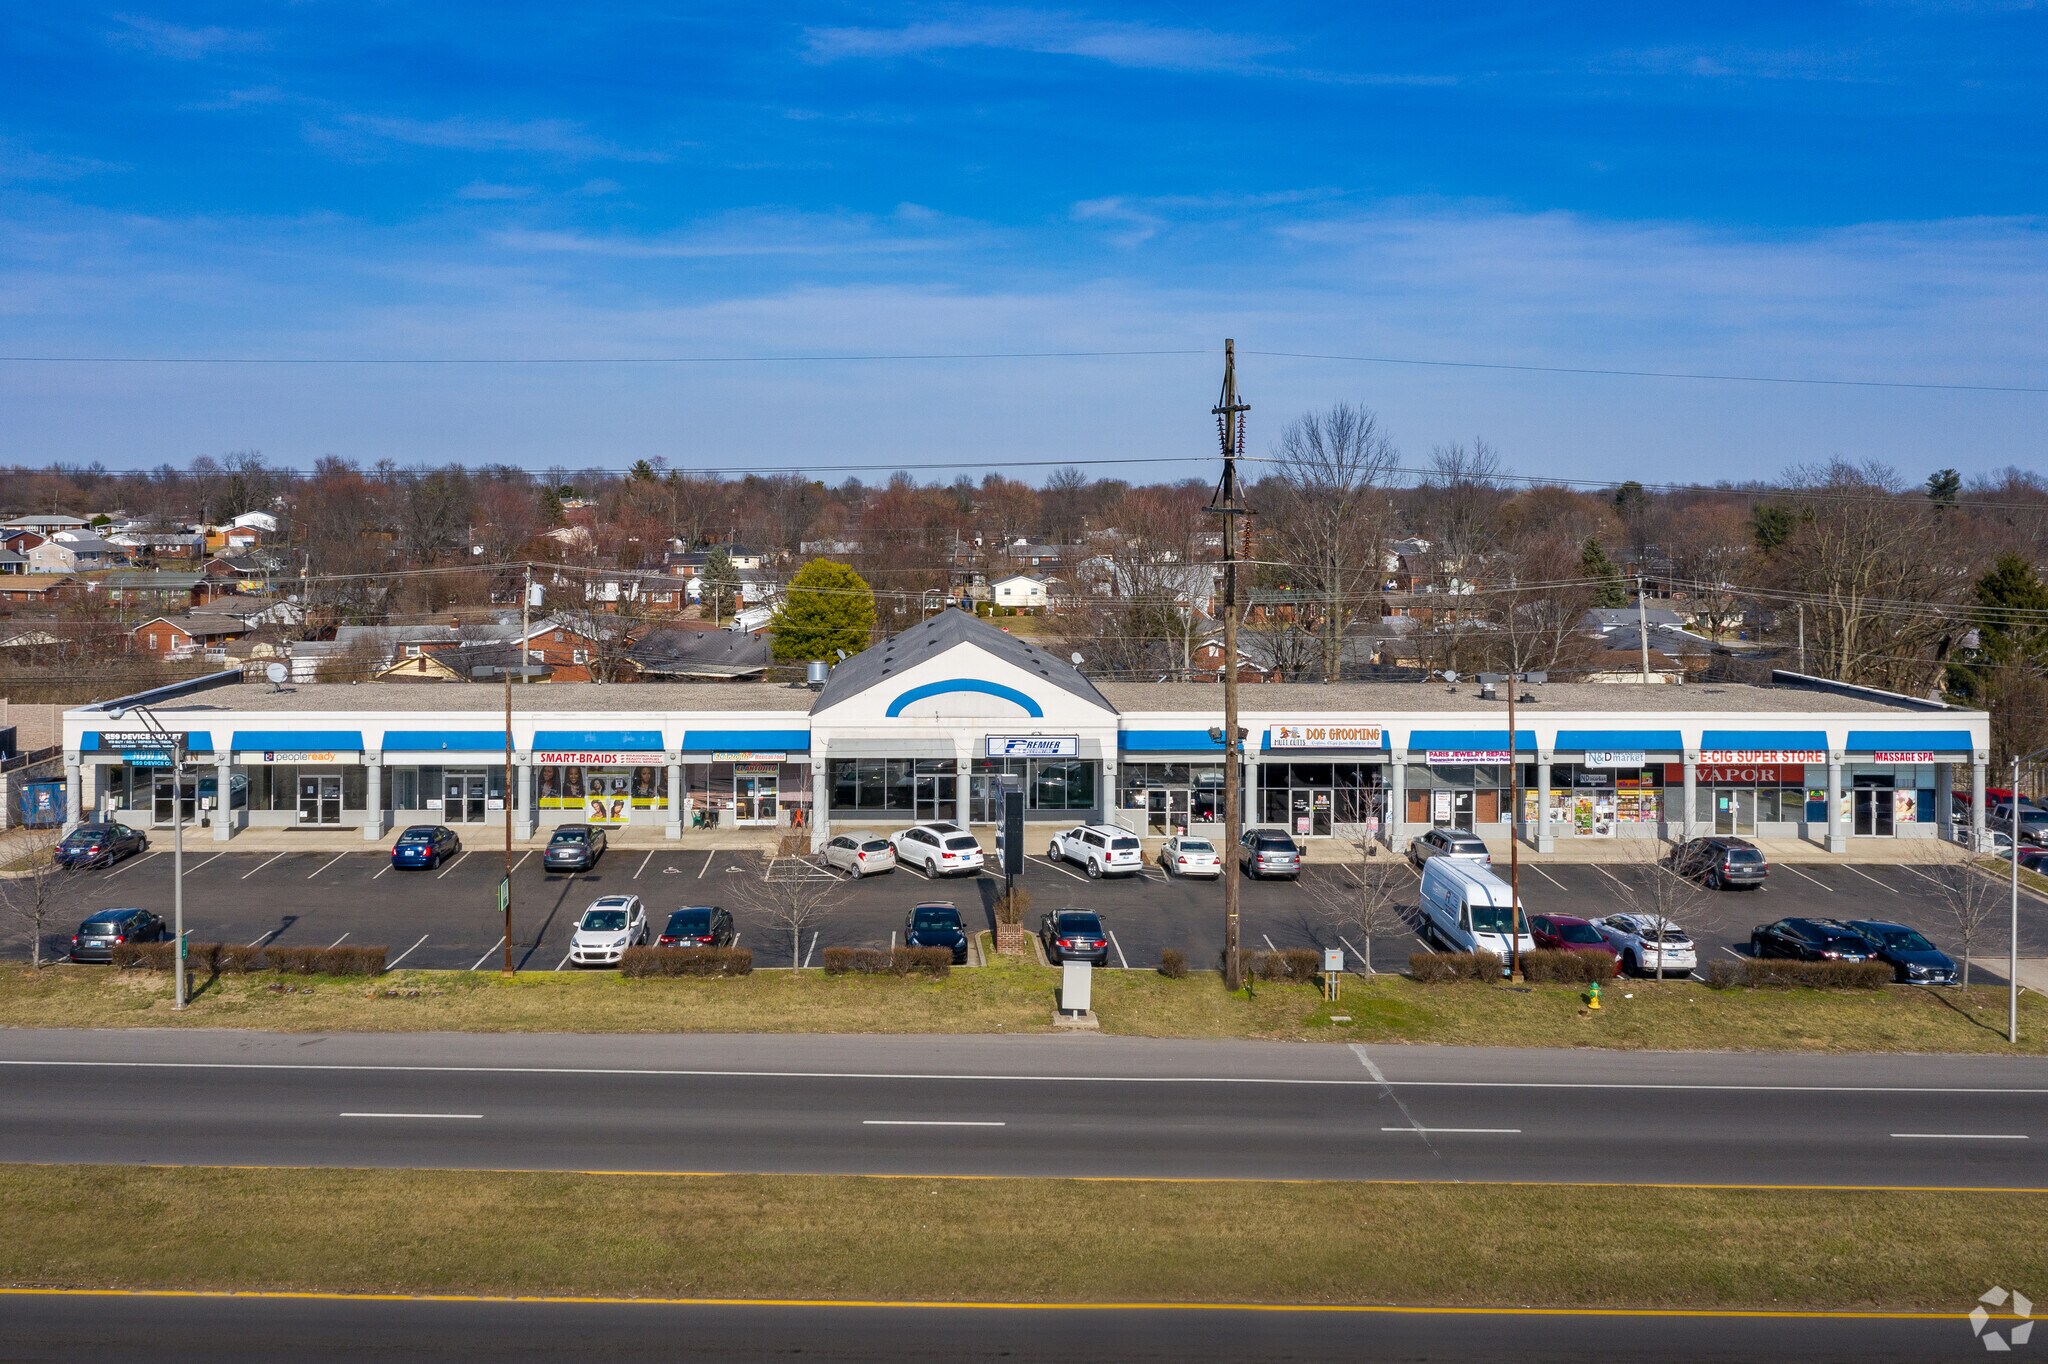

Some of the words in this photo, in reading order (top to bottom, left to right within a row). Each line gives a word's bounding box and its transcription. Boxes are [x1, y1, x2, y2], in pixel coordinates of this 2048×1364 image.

[1306, 728, 1326, 740] DOG
[1329, 728, 1380, 740] GROOMING
[1006, 739, 1061, 749] PREMIER
[133, 751, 155, 760] NOW
[276, 752, 336, 763] peopleready
[540, 753, 617, 763] SMART-BRAIDS
[1613, 753, 1644, 761] market
[1700, 750, 1733, 763] E-CIG
[1737, 750, 1778, 763] SUPER
[1782, 750, 1822, 763] STORE
[1875, 752, 1915, 761] MASSAGE
[1917, 752, 1934, 761] SPA
[1695, 768, 1776, 782] VAPOR
